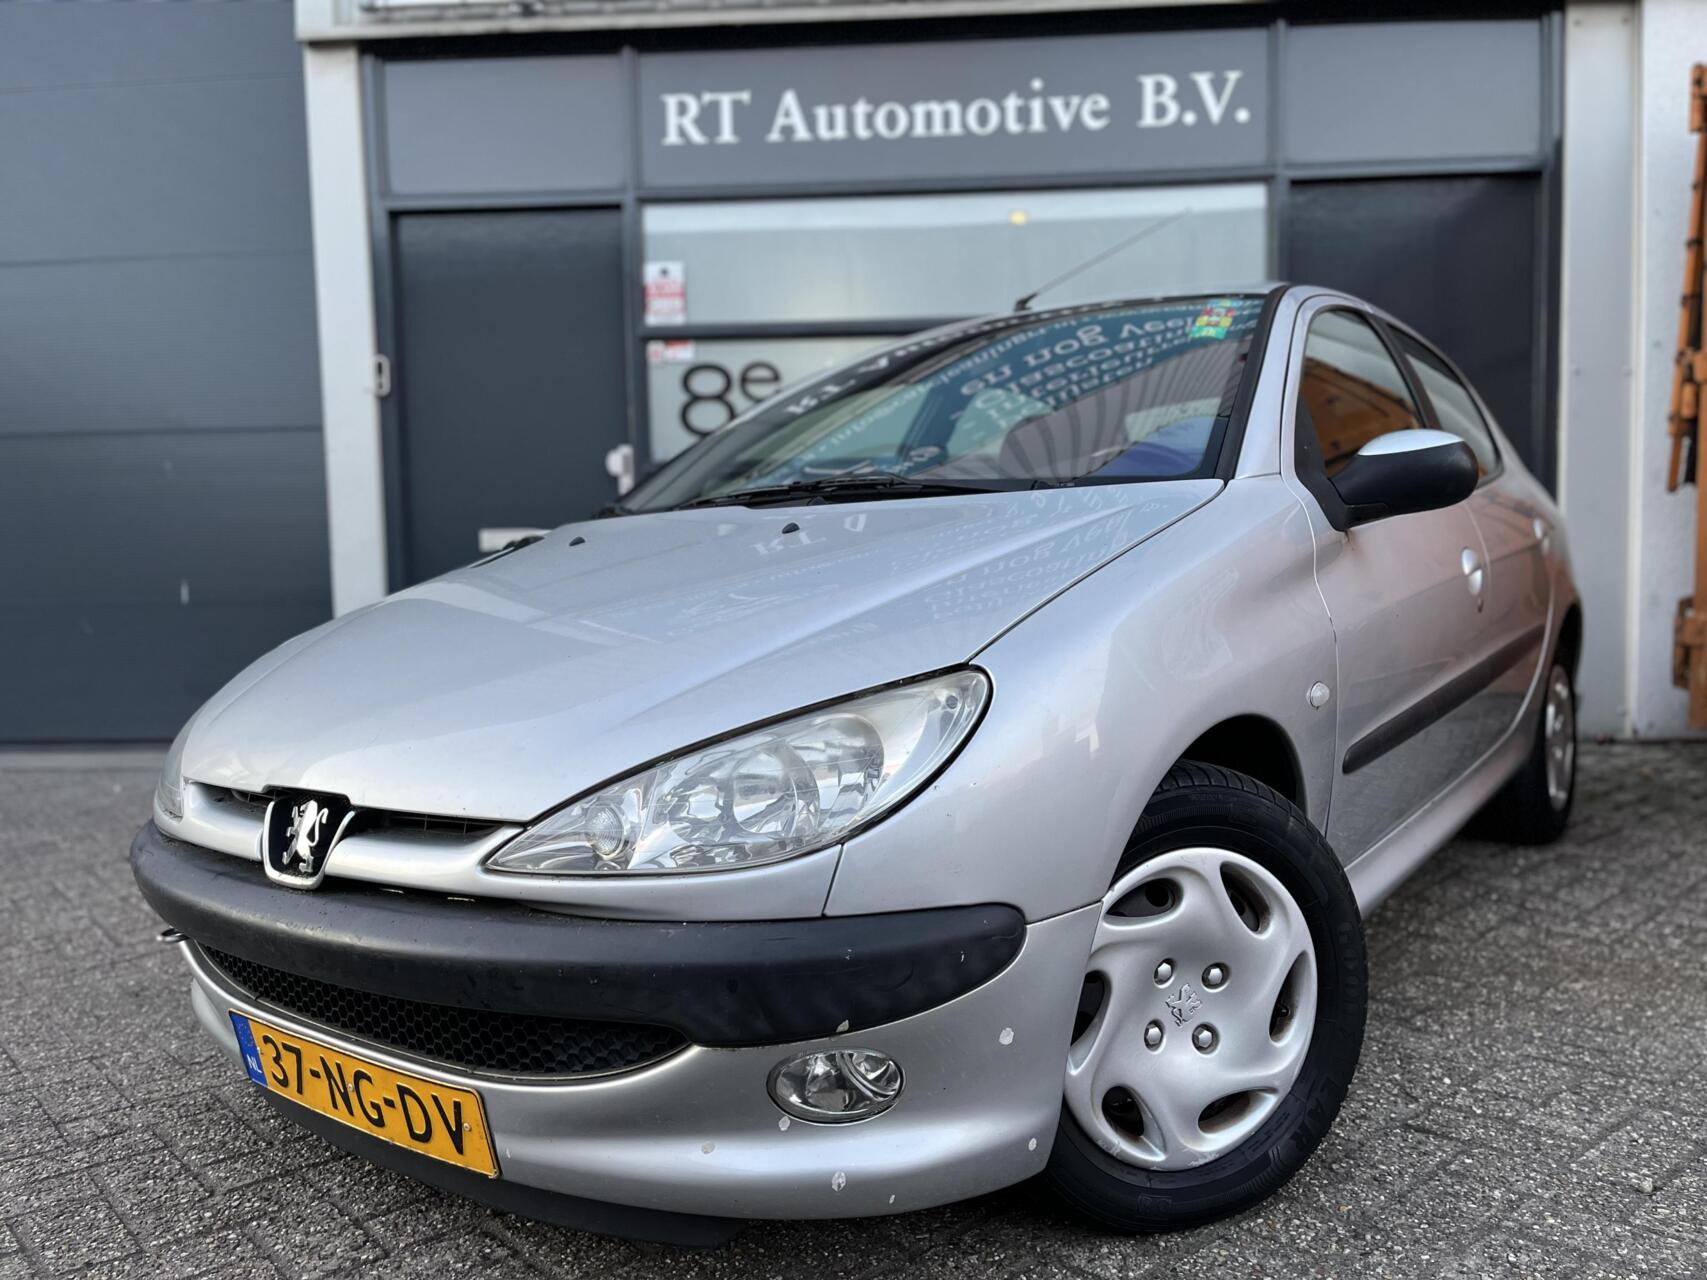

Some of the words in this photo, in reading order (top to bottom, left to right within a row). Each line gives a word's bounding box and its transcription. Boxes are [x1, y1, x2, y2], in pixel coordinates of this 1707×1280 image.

[660, 90, 752, 146] RT
[766, 78, 1111, 143] Automotive
[1136, 70, 1252, 128] B.V.
[681, 361, 781, 437] 8e
[246, 1055, 263, 1075] NL
[261, 1034, 465, 1156] 37-NG-DV
